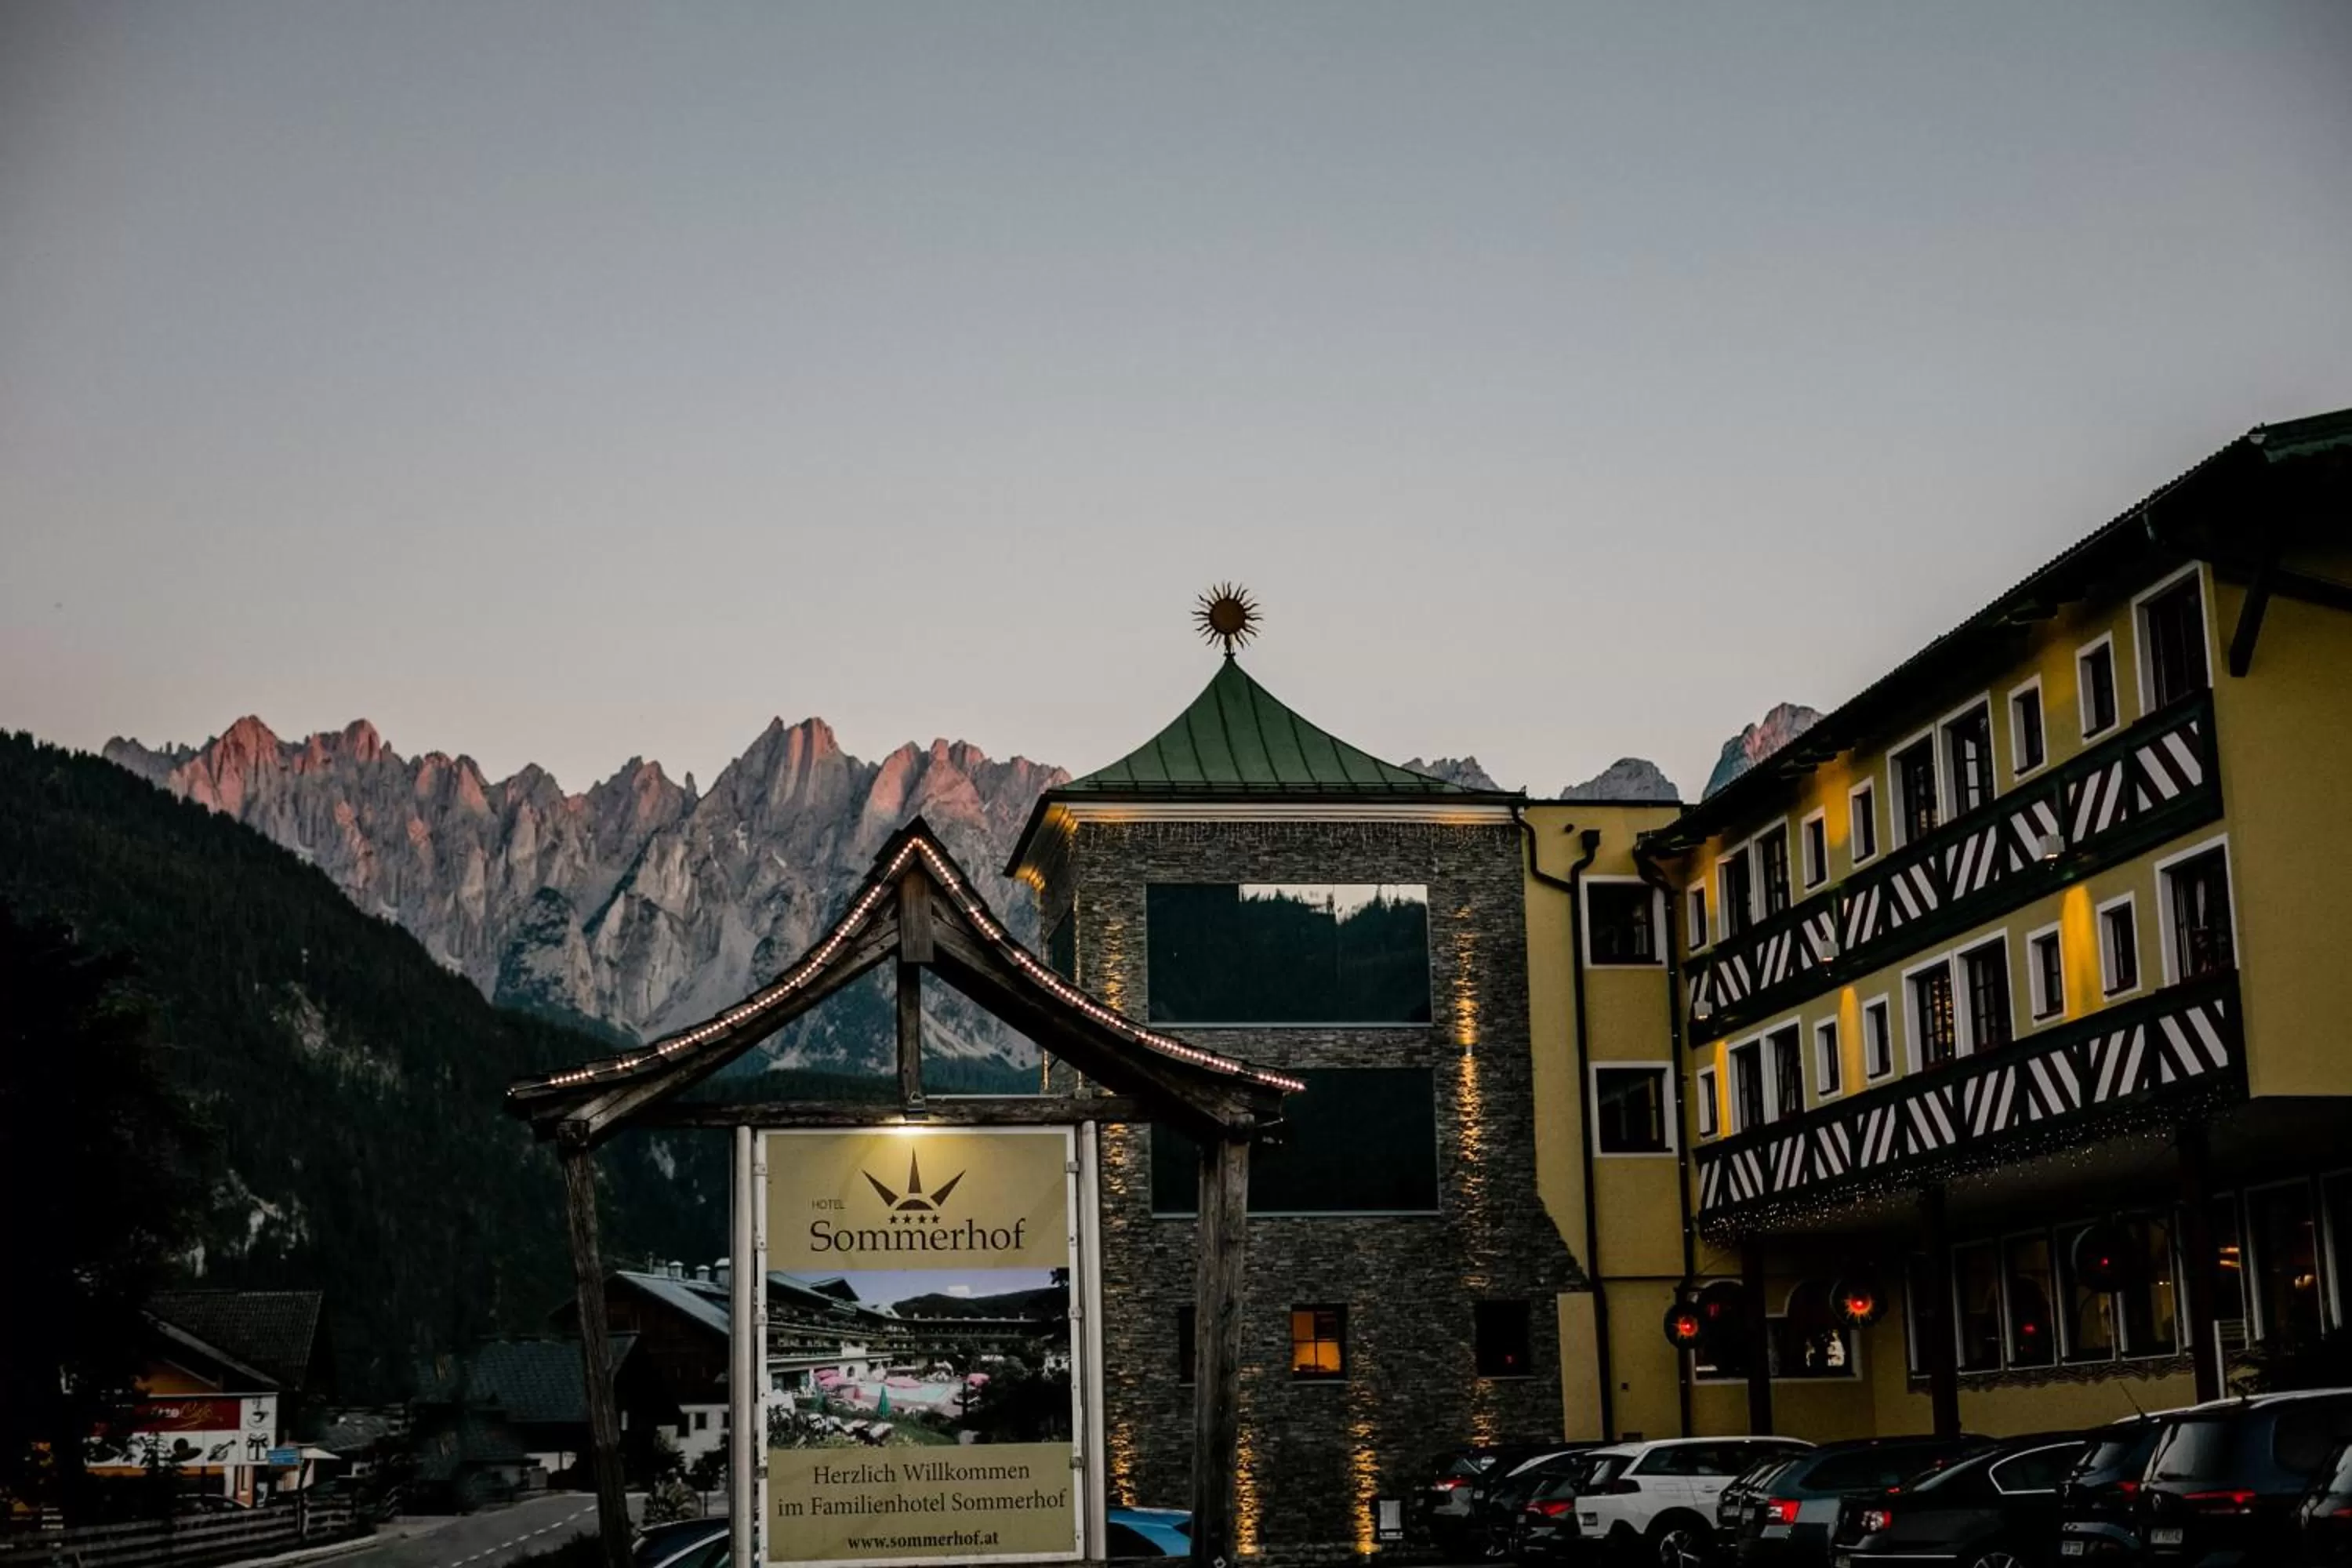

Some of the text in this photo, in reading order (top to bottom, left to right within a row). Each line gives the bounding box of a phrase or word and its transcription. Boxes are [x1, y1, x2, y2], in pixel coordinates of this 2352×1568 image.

[812, 1198, 845, 1210] HOTEL
[810, 1218, 1026, 1252] Sommerhof
[814, 1461, 1030, 1484] Herzlich Willkommen
[778, 1488, 1067, 1517] im Familienhotel Sommerhof
[848, 1530, 999, 1550] www.sommerhof.at
